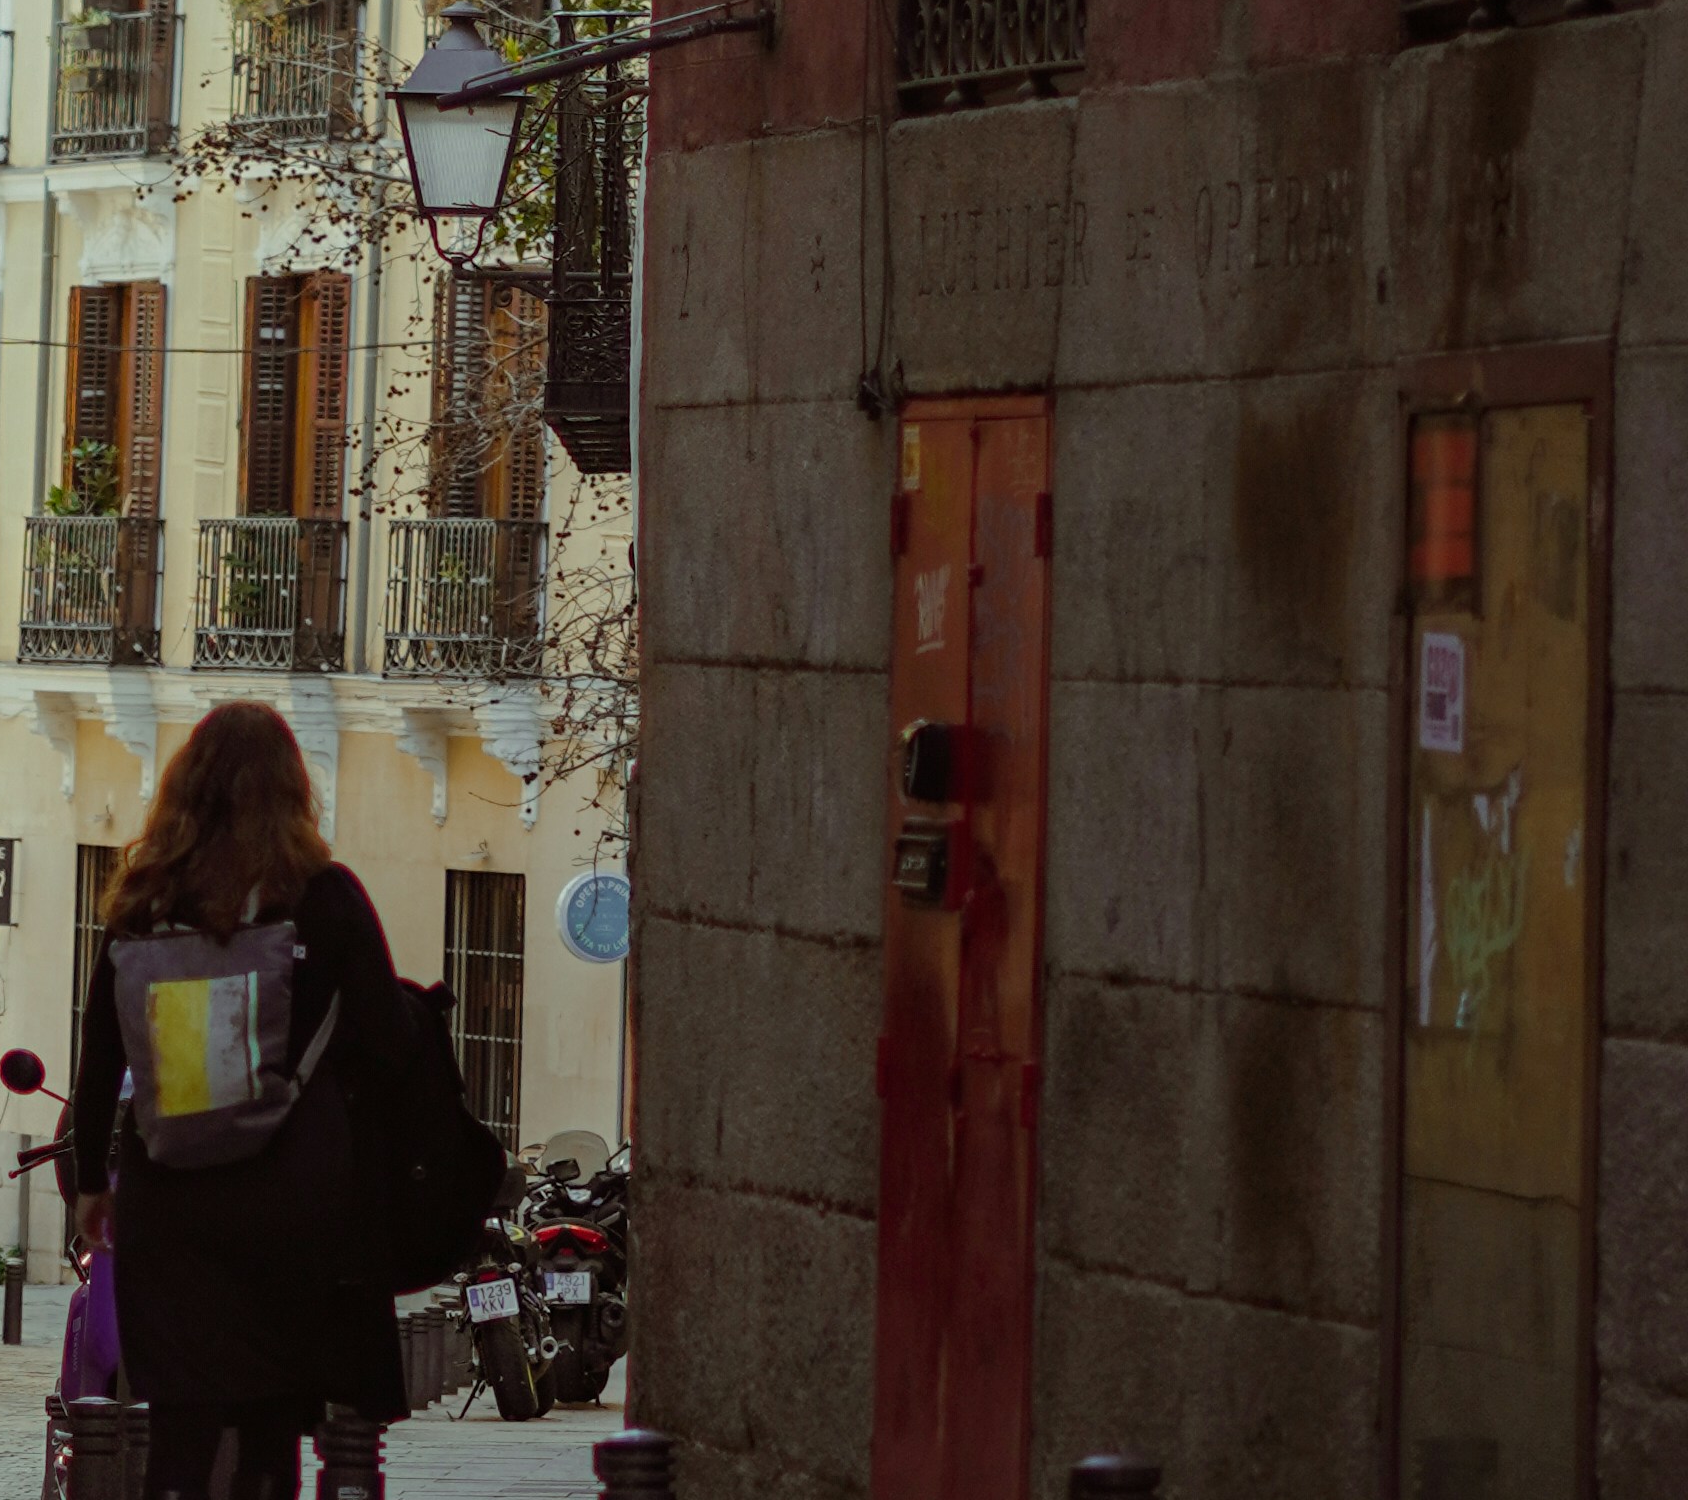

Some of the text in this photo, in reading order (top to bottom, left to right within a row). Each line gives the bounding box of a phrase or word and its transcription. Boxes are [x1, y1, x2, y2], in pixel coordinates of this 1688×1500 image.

[917, 198, 1091, 296] LUTHIER
[480, 1282, 512, 1299] 1239
[480, 1297, 505, 1314] KKV
